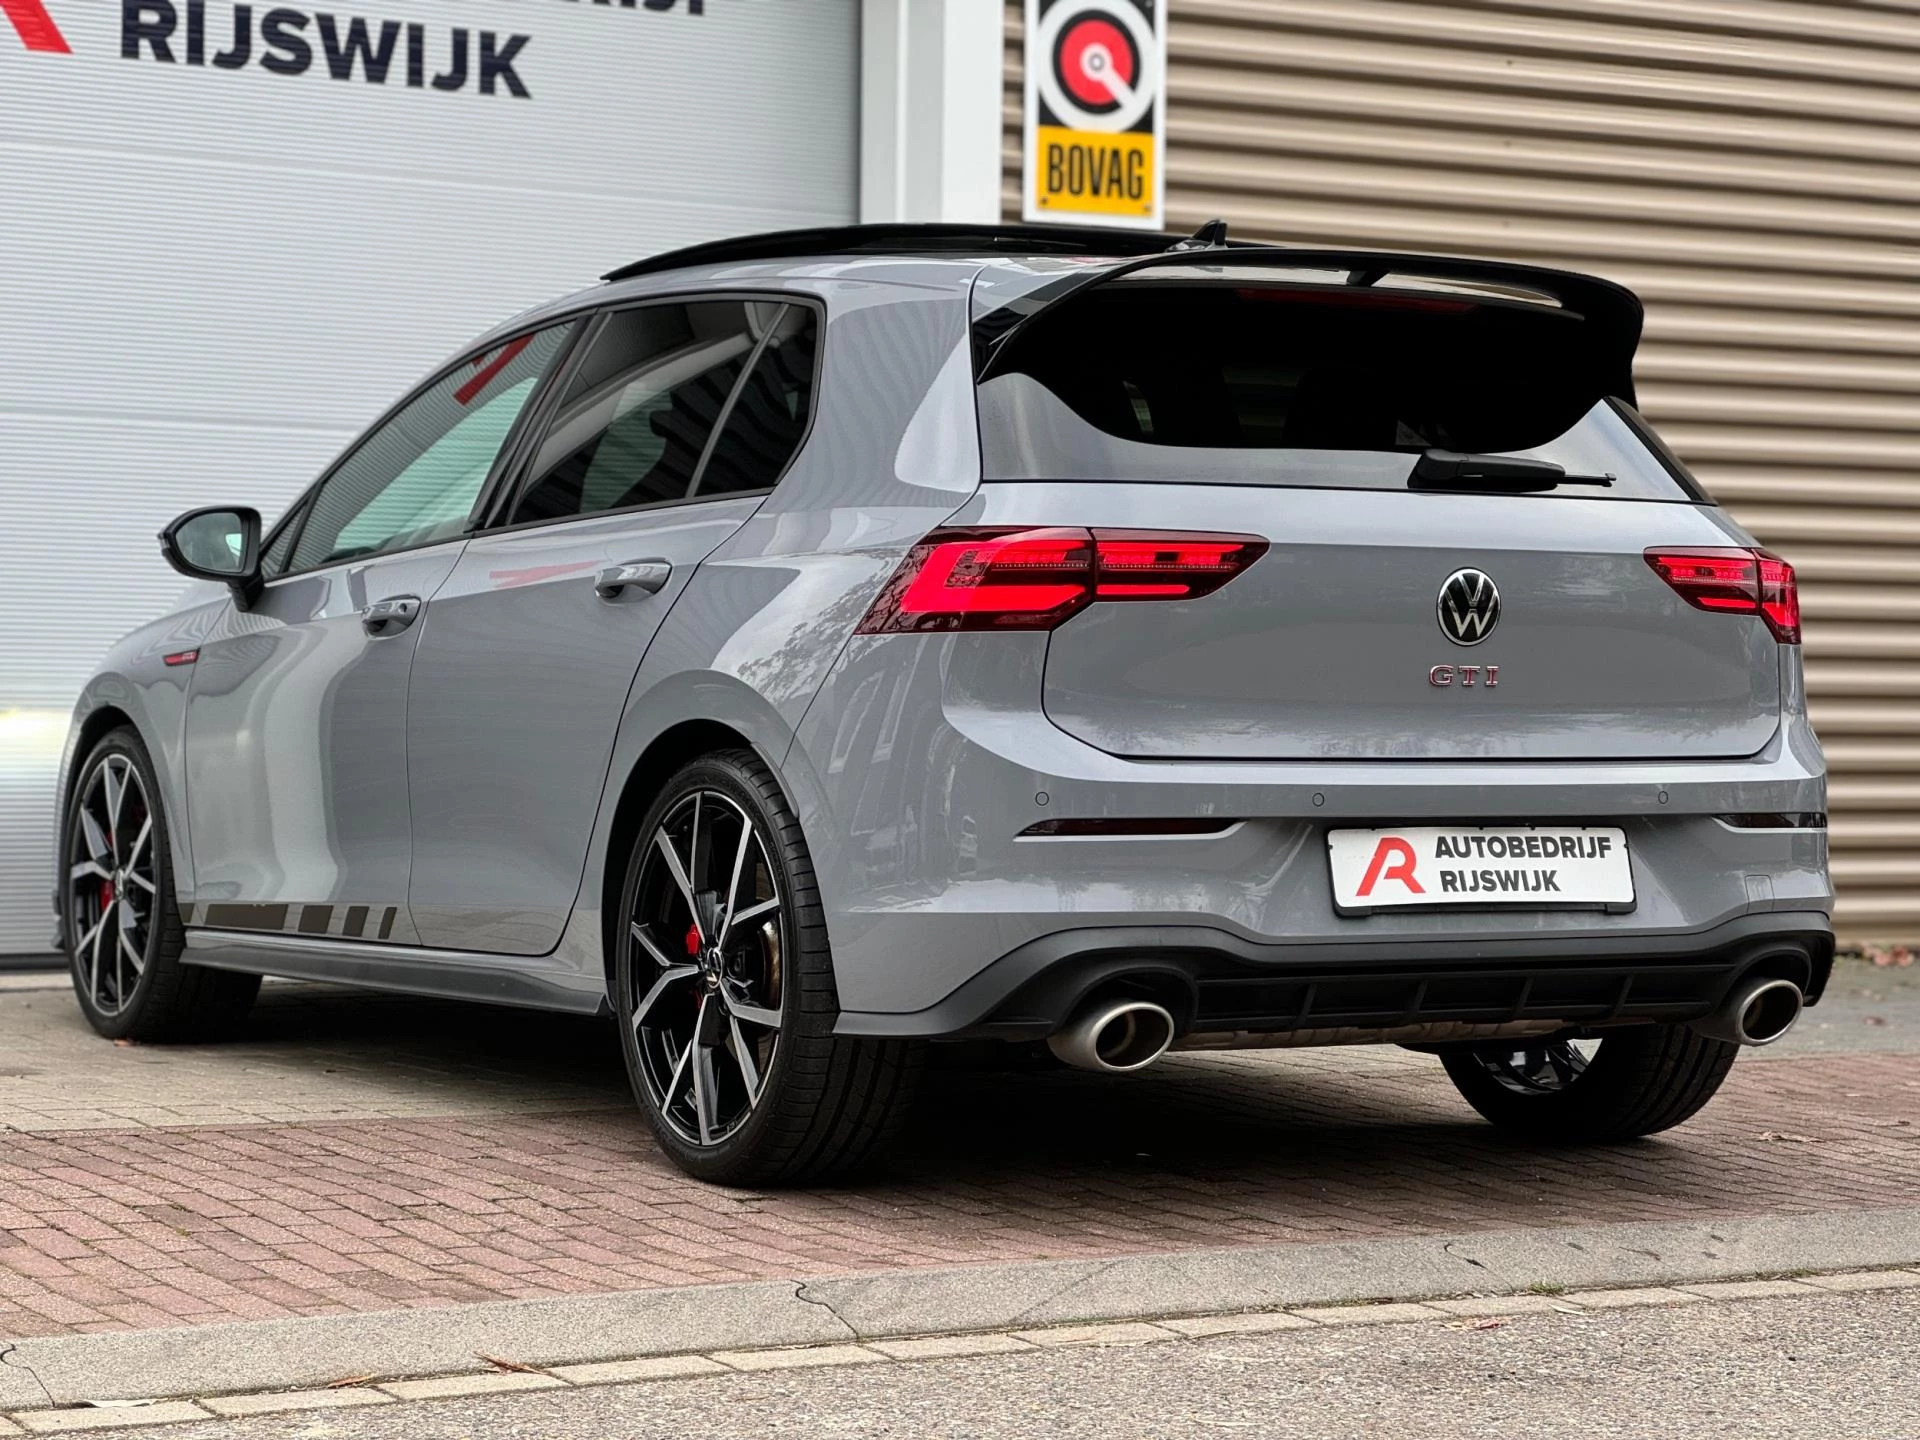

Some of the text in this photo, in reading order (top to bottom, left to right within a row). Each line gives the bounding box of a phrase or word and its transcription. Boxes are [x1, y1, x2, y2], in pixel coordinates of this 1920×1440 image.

[121, 0, 532, 99] RIJSWIJK
[1048, 143, 1143, 199] BOVAG
[1429, 664, 1500, 686] GTI
[1435, 836, 1612, 859] AUTOBEDRIJF
[1439, 870, 1561, 892] RIJSWIJK
